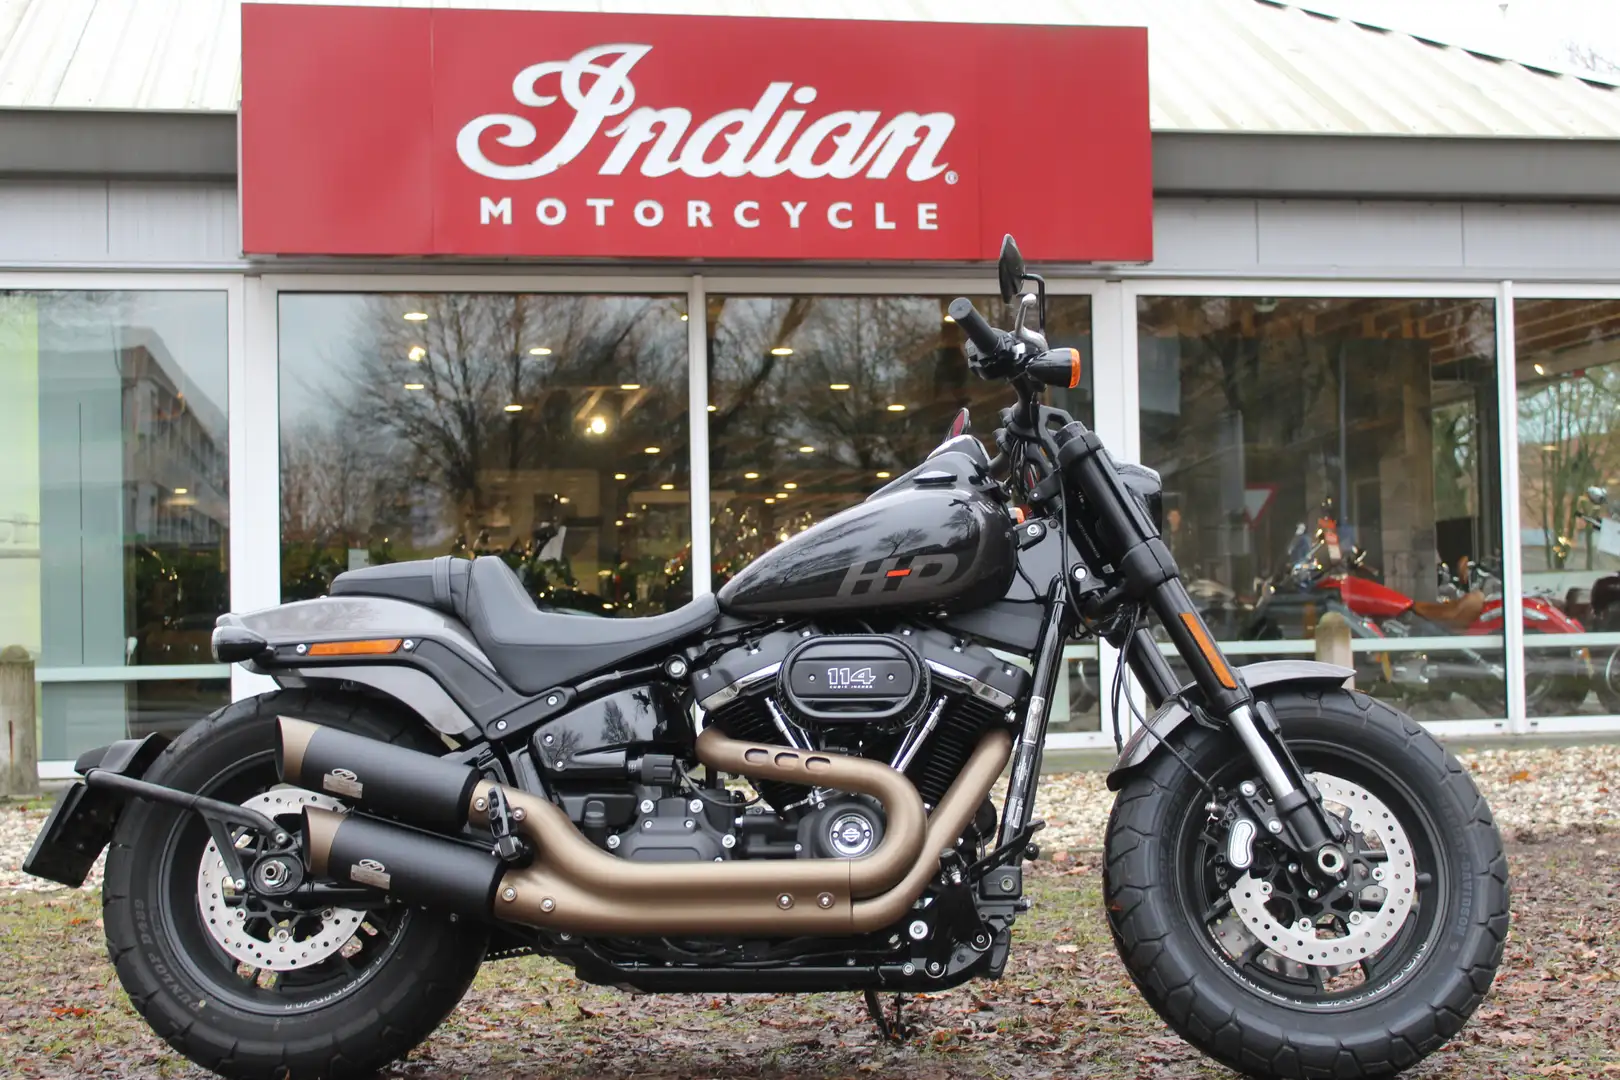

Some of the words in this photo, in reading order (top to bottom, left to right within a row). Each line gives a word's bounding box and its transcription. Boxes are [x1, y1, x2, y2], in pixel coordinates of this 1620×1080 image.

[456, 43, 956, 181] Indian
[480, 197, 939, 231] MOTORCYCLE
[827, 667, 876, 684] 114
[147, 952, 202, 1013] DUNLOP
